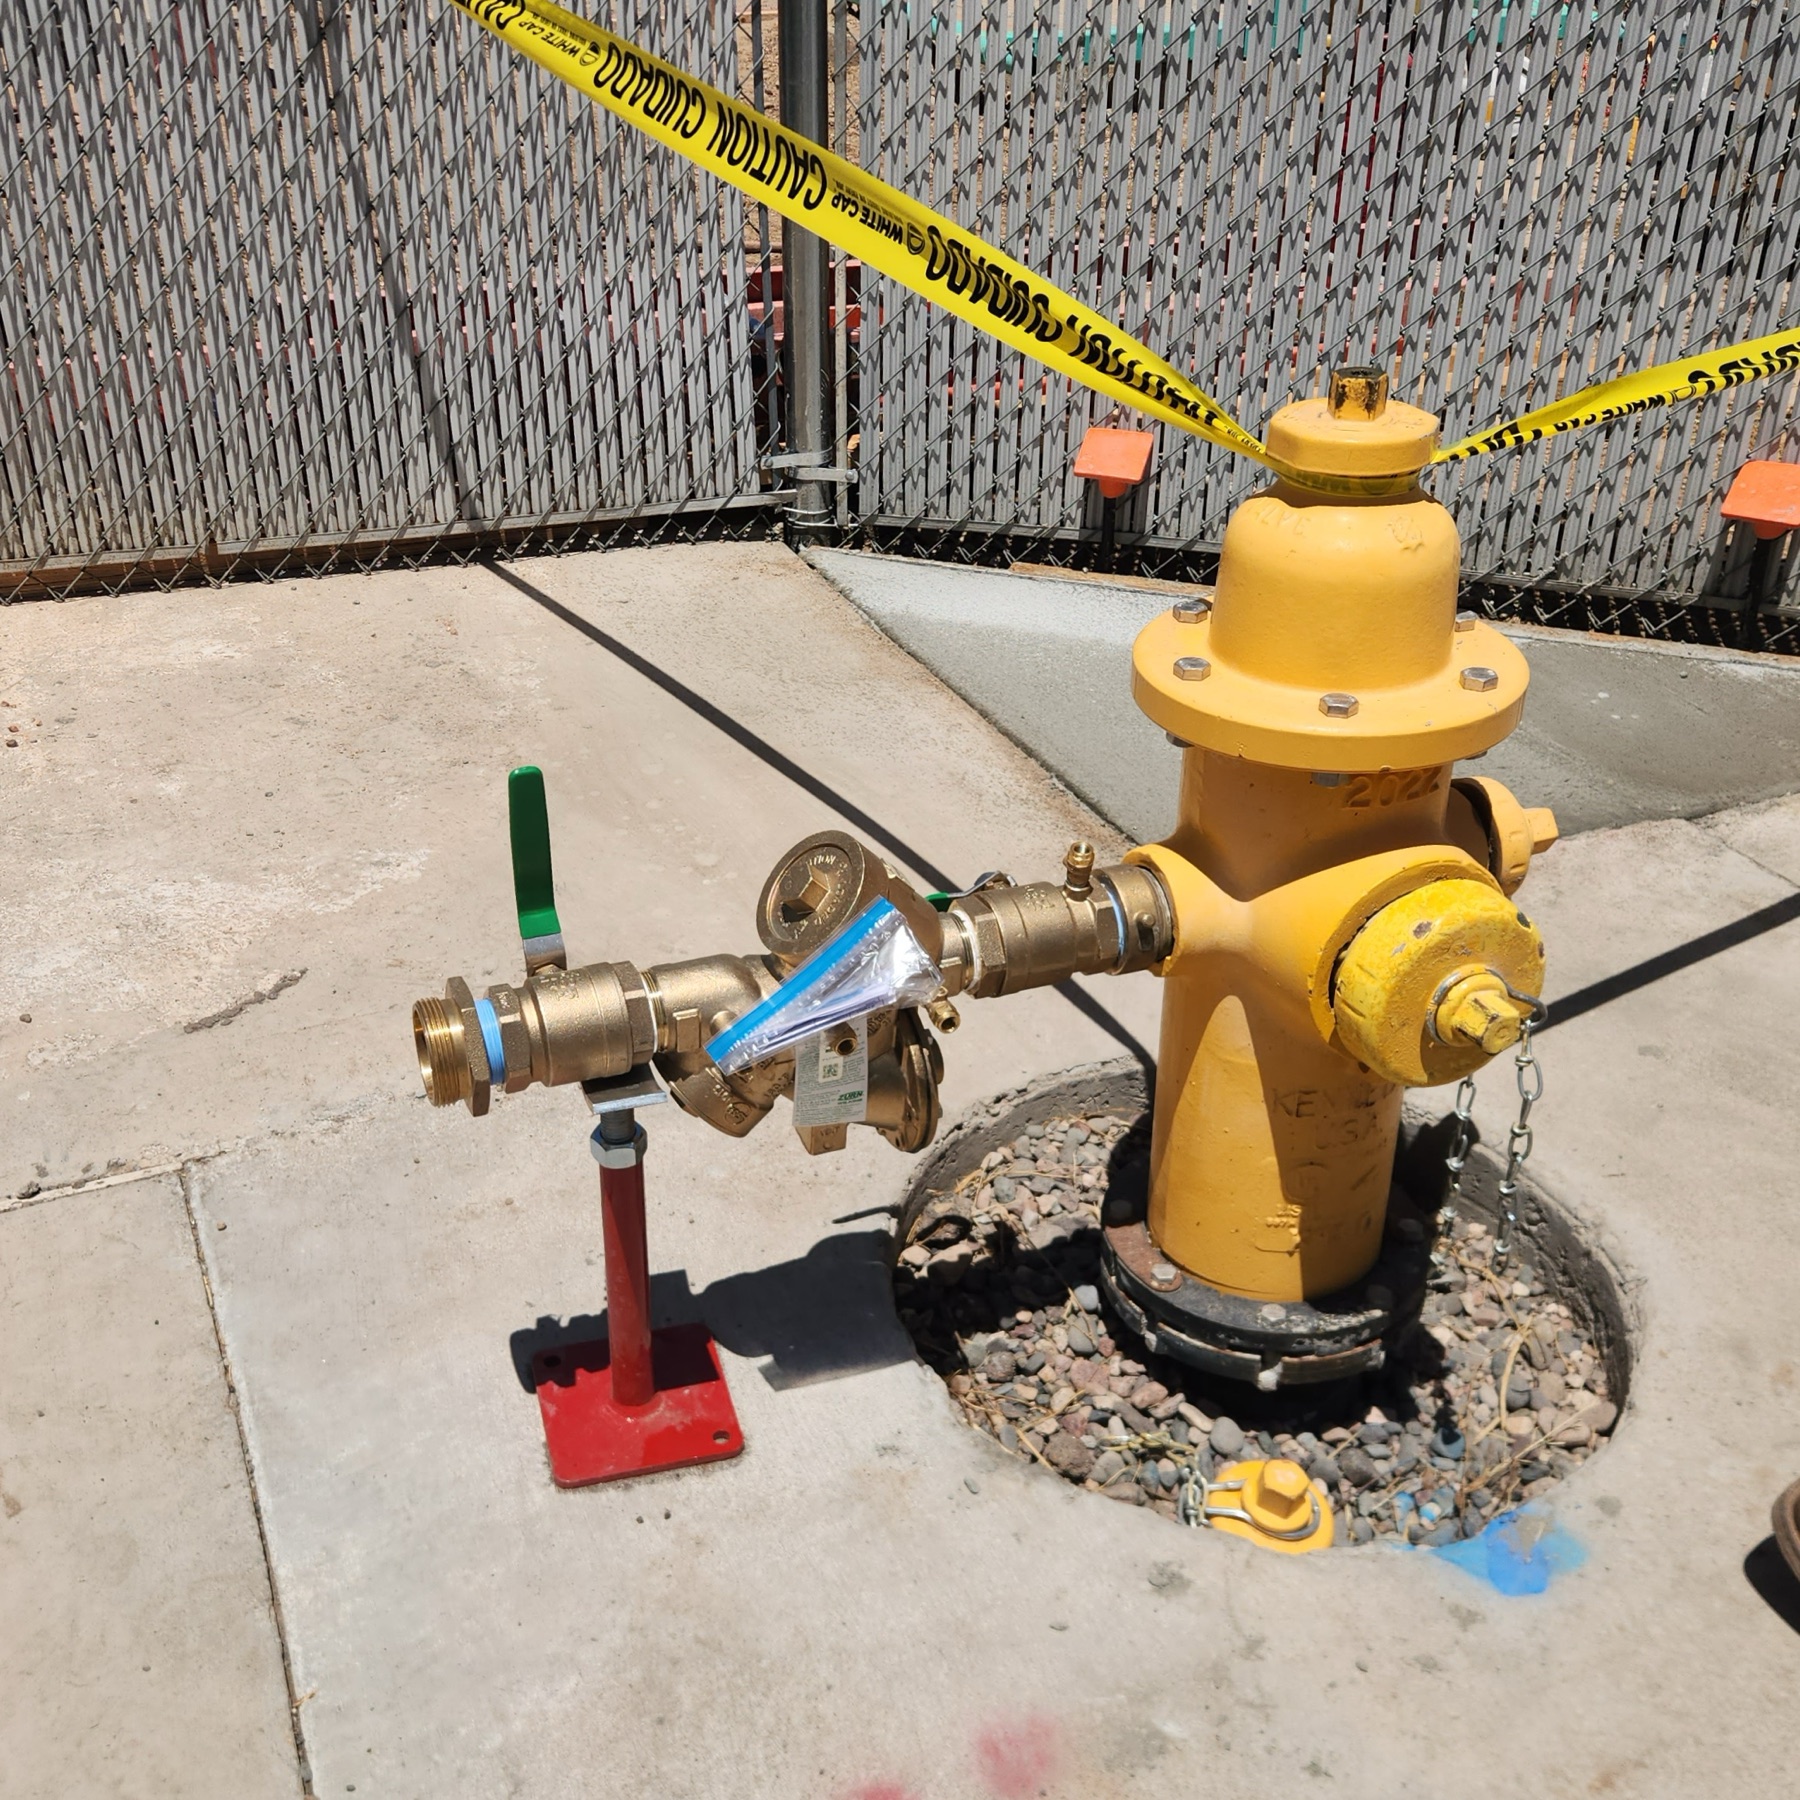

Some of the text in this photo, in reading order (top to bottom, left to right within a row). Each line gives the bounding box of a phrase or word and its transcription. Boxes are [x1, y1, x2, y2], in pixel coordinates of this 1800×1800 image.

[518, 19, 545, 36] CAP
[541, 31, 581, 57] WHITE
[593, 41, 707, 139] CUIDADO
[707, 101, 829, 210] CAUTION
[831, 192, 859, 219] CAP
[859, 206, 903, 245] WHITE
[924, 224, 1064, 342] CUIDADO
